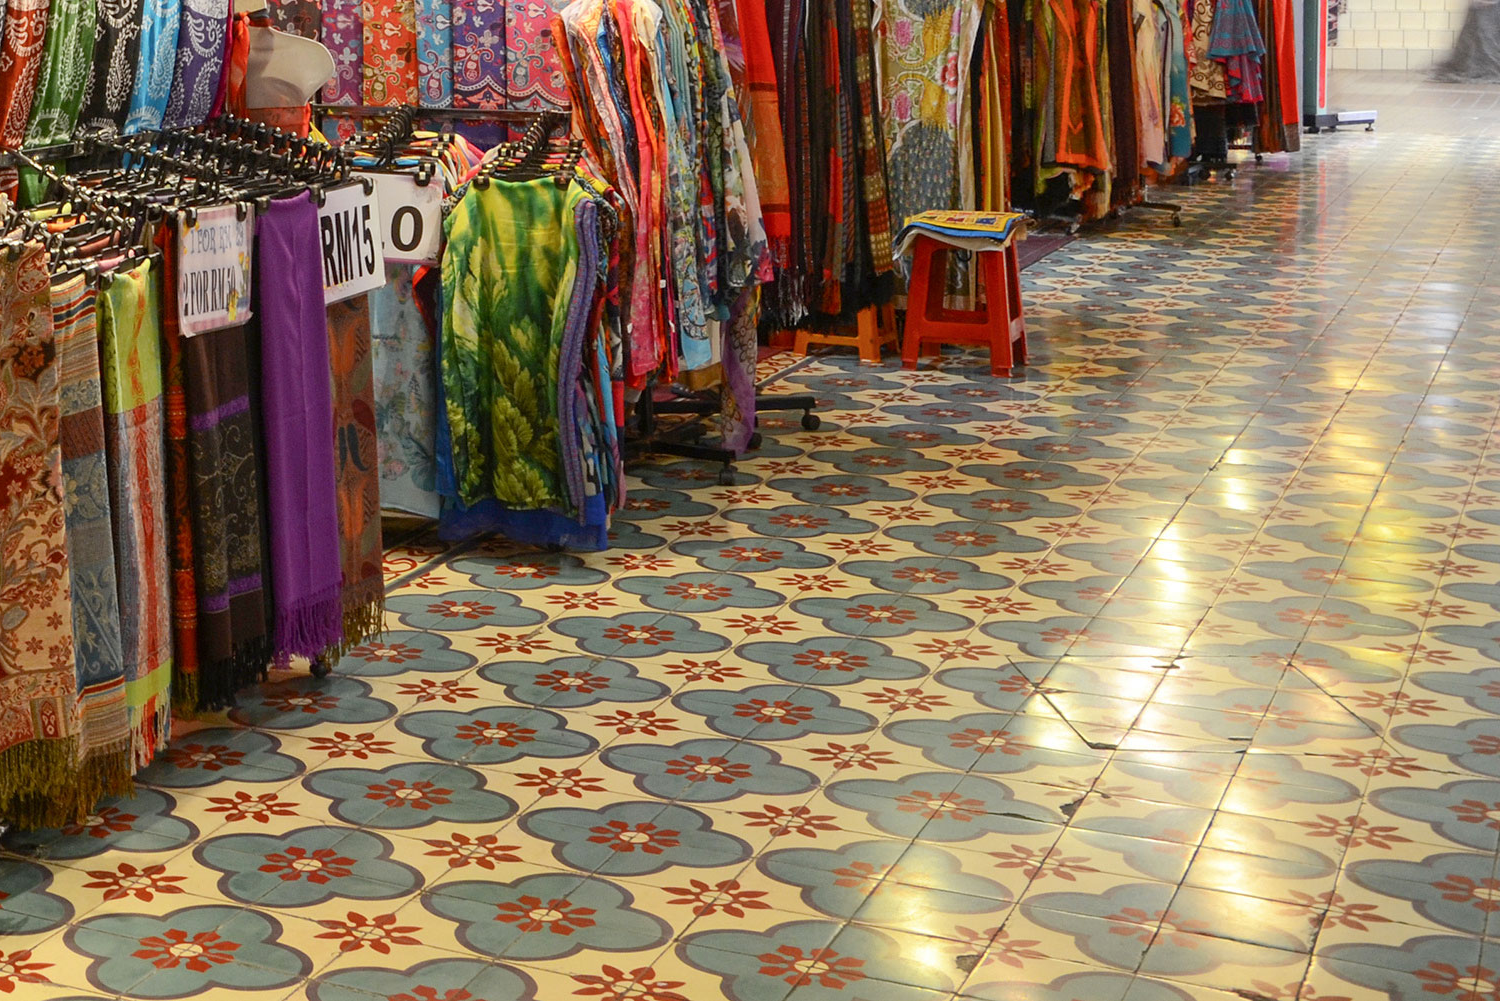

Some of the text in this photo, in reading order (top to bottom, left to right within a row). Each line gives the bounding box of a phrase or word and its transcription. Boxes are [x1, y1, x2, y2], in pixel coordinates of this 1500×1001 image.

[197, 227, 216, 254] FOR
[320, 204, 375, 288] RM15
[183, 272, 189, 316] 2
[190, 270, 209, 315] FOR
